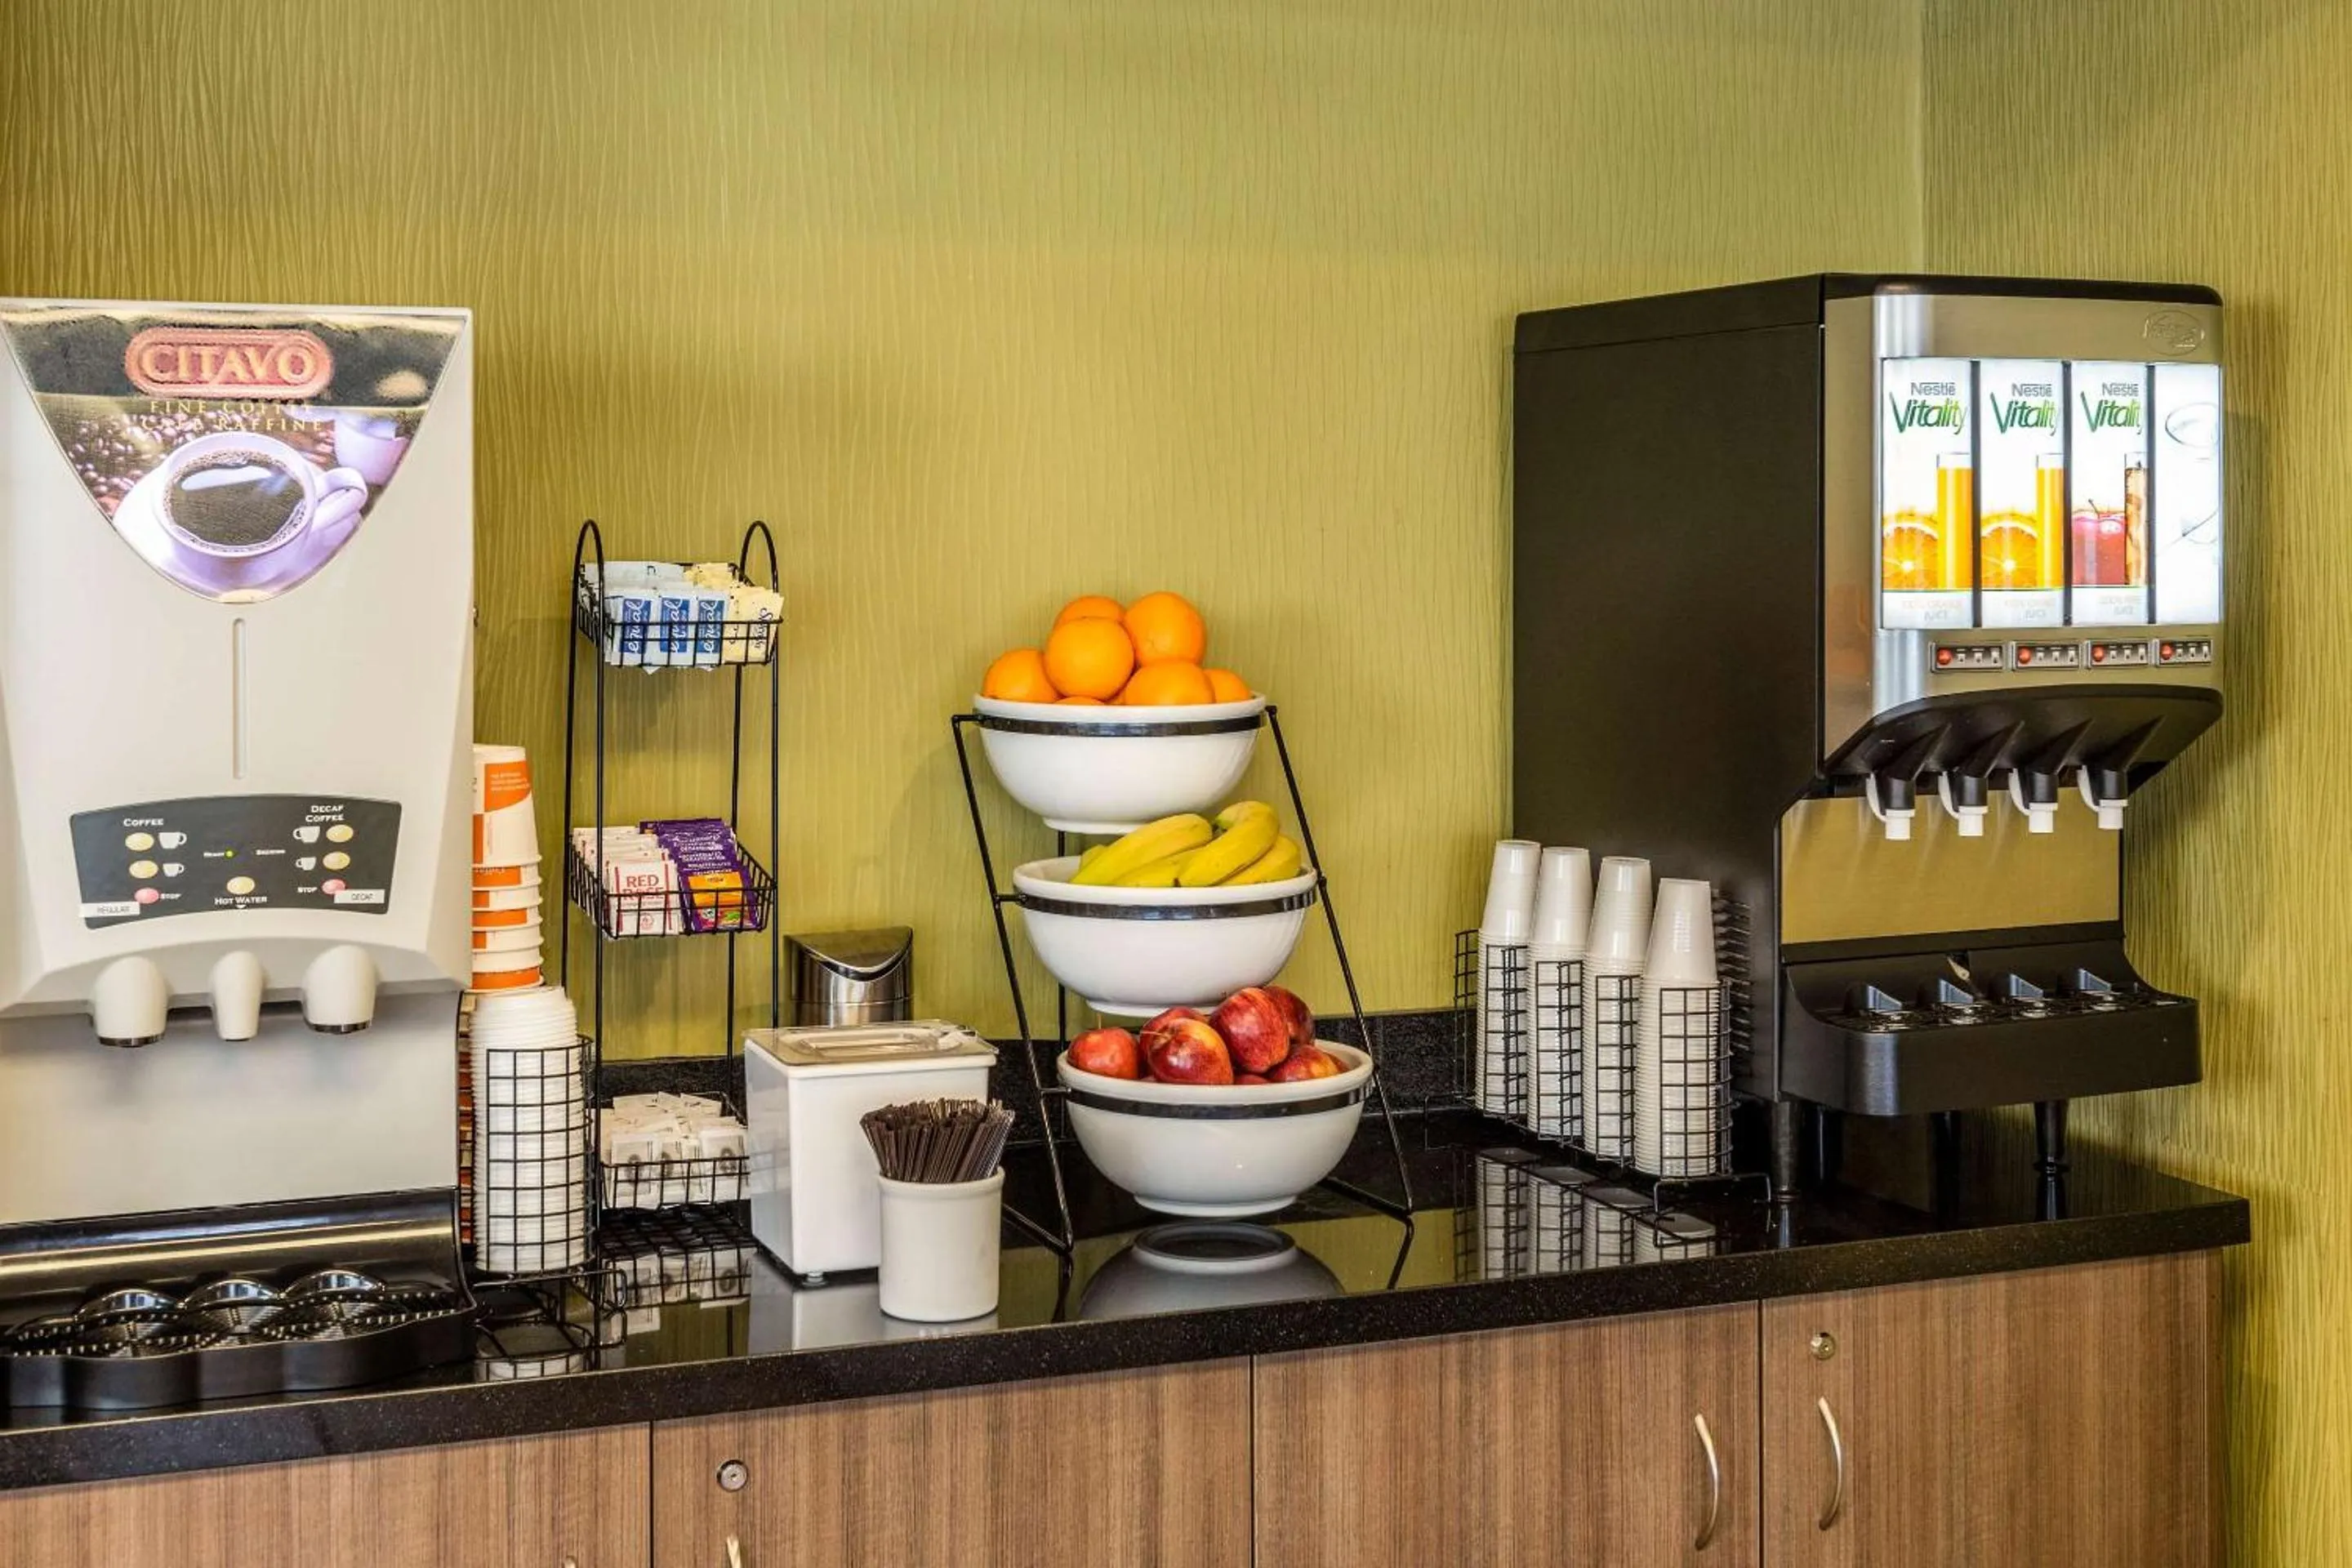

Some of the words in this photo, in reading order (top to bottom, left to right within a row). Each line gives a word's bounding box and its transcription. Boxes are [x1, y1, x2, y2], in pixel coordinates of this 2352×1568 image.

[141, 343, 314, 383] CITAVO
[149, 400, 207, 413] FINE
[1888, 391, 1968, 435] Vitality
[310, 804, 344, 813] DECAF
[122, 817, 164, 827] COFFEE
[305, 814, 344, 822] COFFEE
[626, 874, 659, 888] RED
[234, 896, 268, 904] WATER
